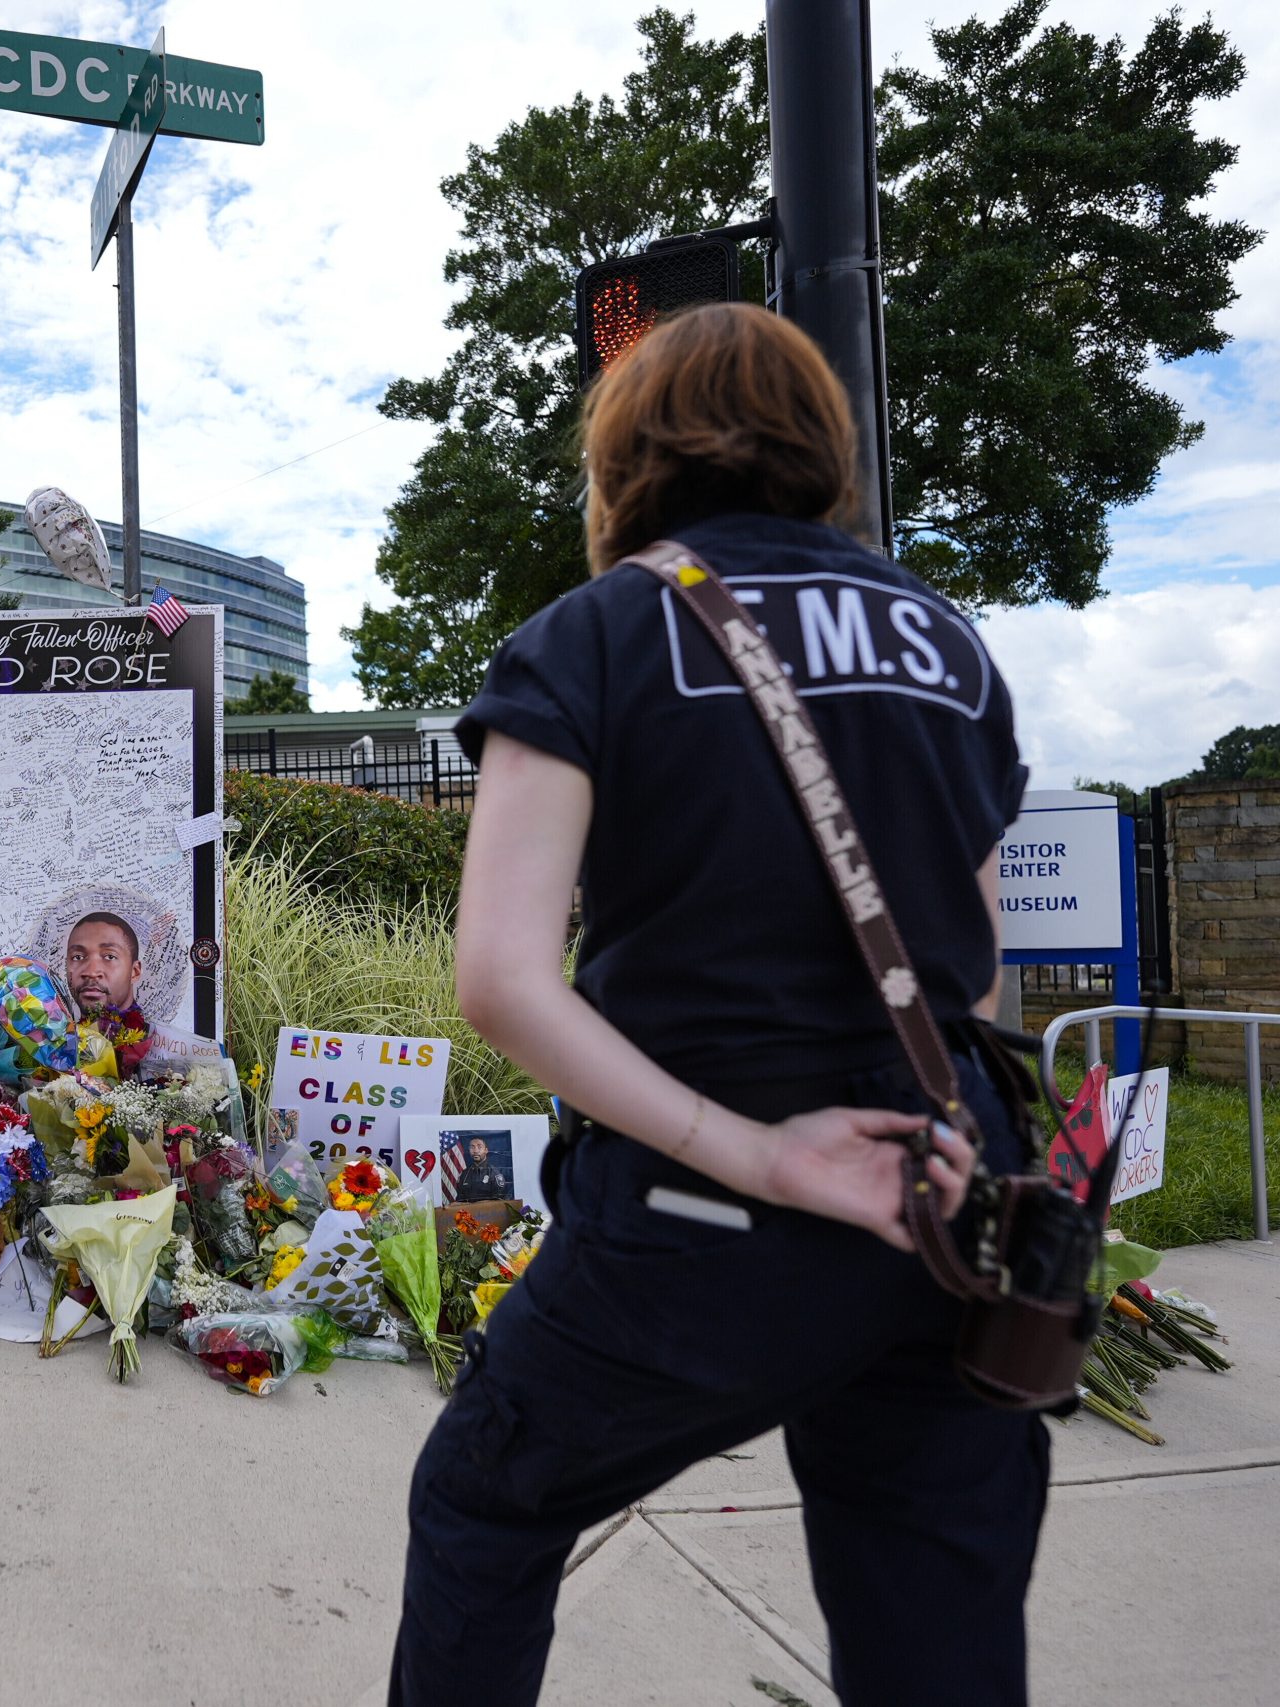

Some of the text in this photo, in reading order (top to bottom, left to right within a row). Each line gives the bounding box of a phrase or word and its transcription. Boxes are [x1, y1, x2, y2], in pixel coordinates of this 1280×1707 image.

[144, 73, 158, 118] RD
[9, 622, 78, 655] Fallen
[78, 620, 154, 652] Officer
[50, 653, 170, 686] ROSE
[997, 842, 1067, 860] ISITOR
[998, 862, 1061, 879] ENTER
[192, 1043, 220, 1057] ROSE
[290, 1033, 343, 1060] EIS
[379, 1041, 434, 1067] LLS
[298, 1077, 408, 1109] CLASS
[1112, 1084, 1139, 1121] WE
[330, 1113, 376, 1137] OF
[1124, 1123, 1154, 1161] CDC
[1109, 1150, 1159, 1197] WORKERS
